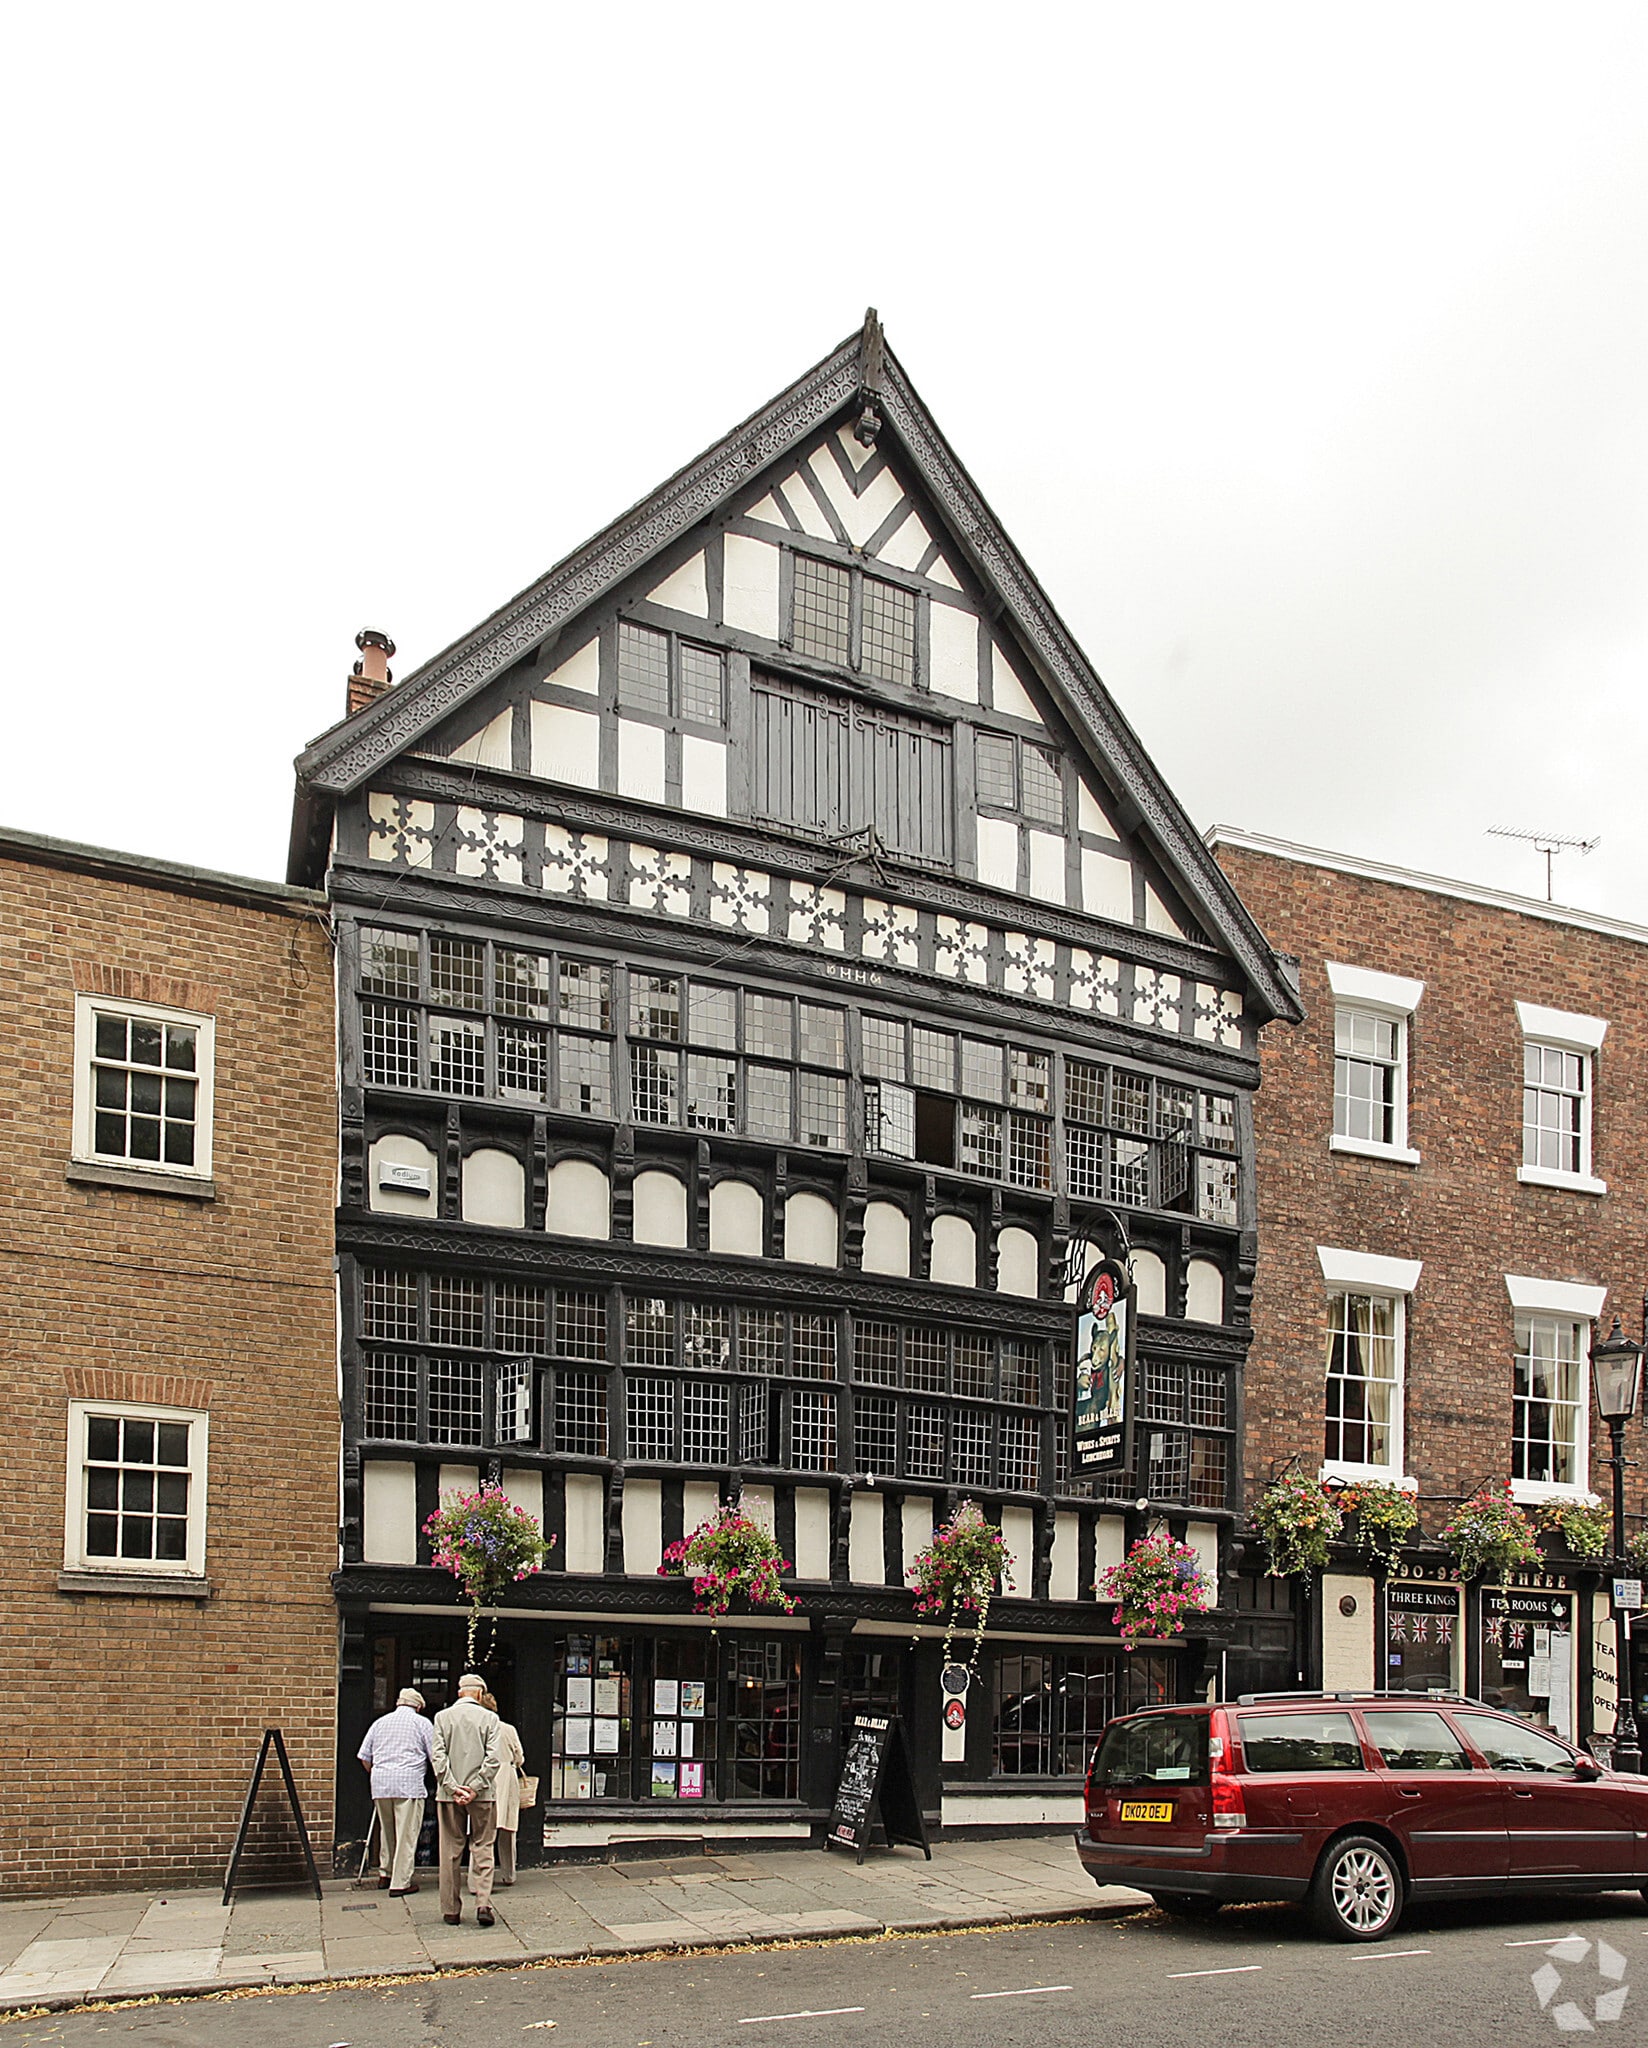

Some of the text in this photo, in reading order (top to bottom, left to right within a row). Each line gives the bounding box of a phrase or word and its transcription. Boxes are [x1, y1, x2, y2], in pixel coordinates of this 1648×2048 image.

[1078, 1412, 1094, 1425] BEAR
[1389, 1591, 1457, 1606] THREE KINGS
[1489, 1598, 1548, 1612] TEA ROOMS
[1595, 1640, 1616, 1658] TEA
[681, 1787, 700, 1795] open
